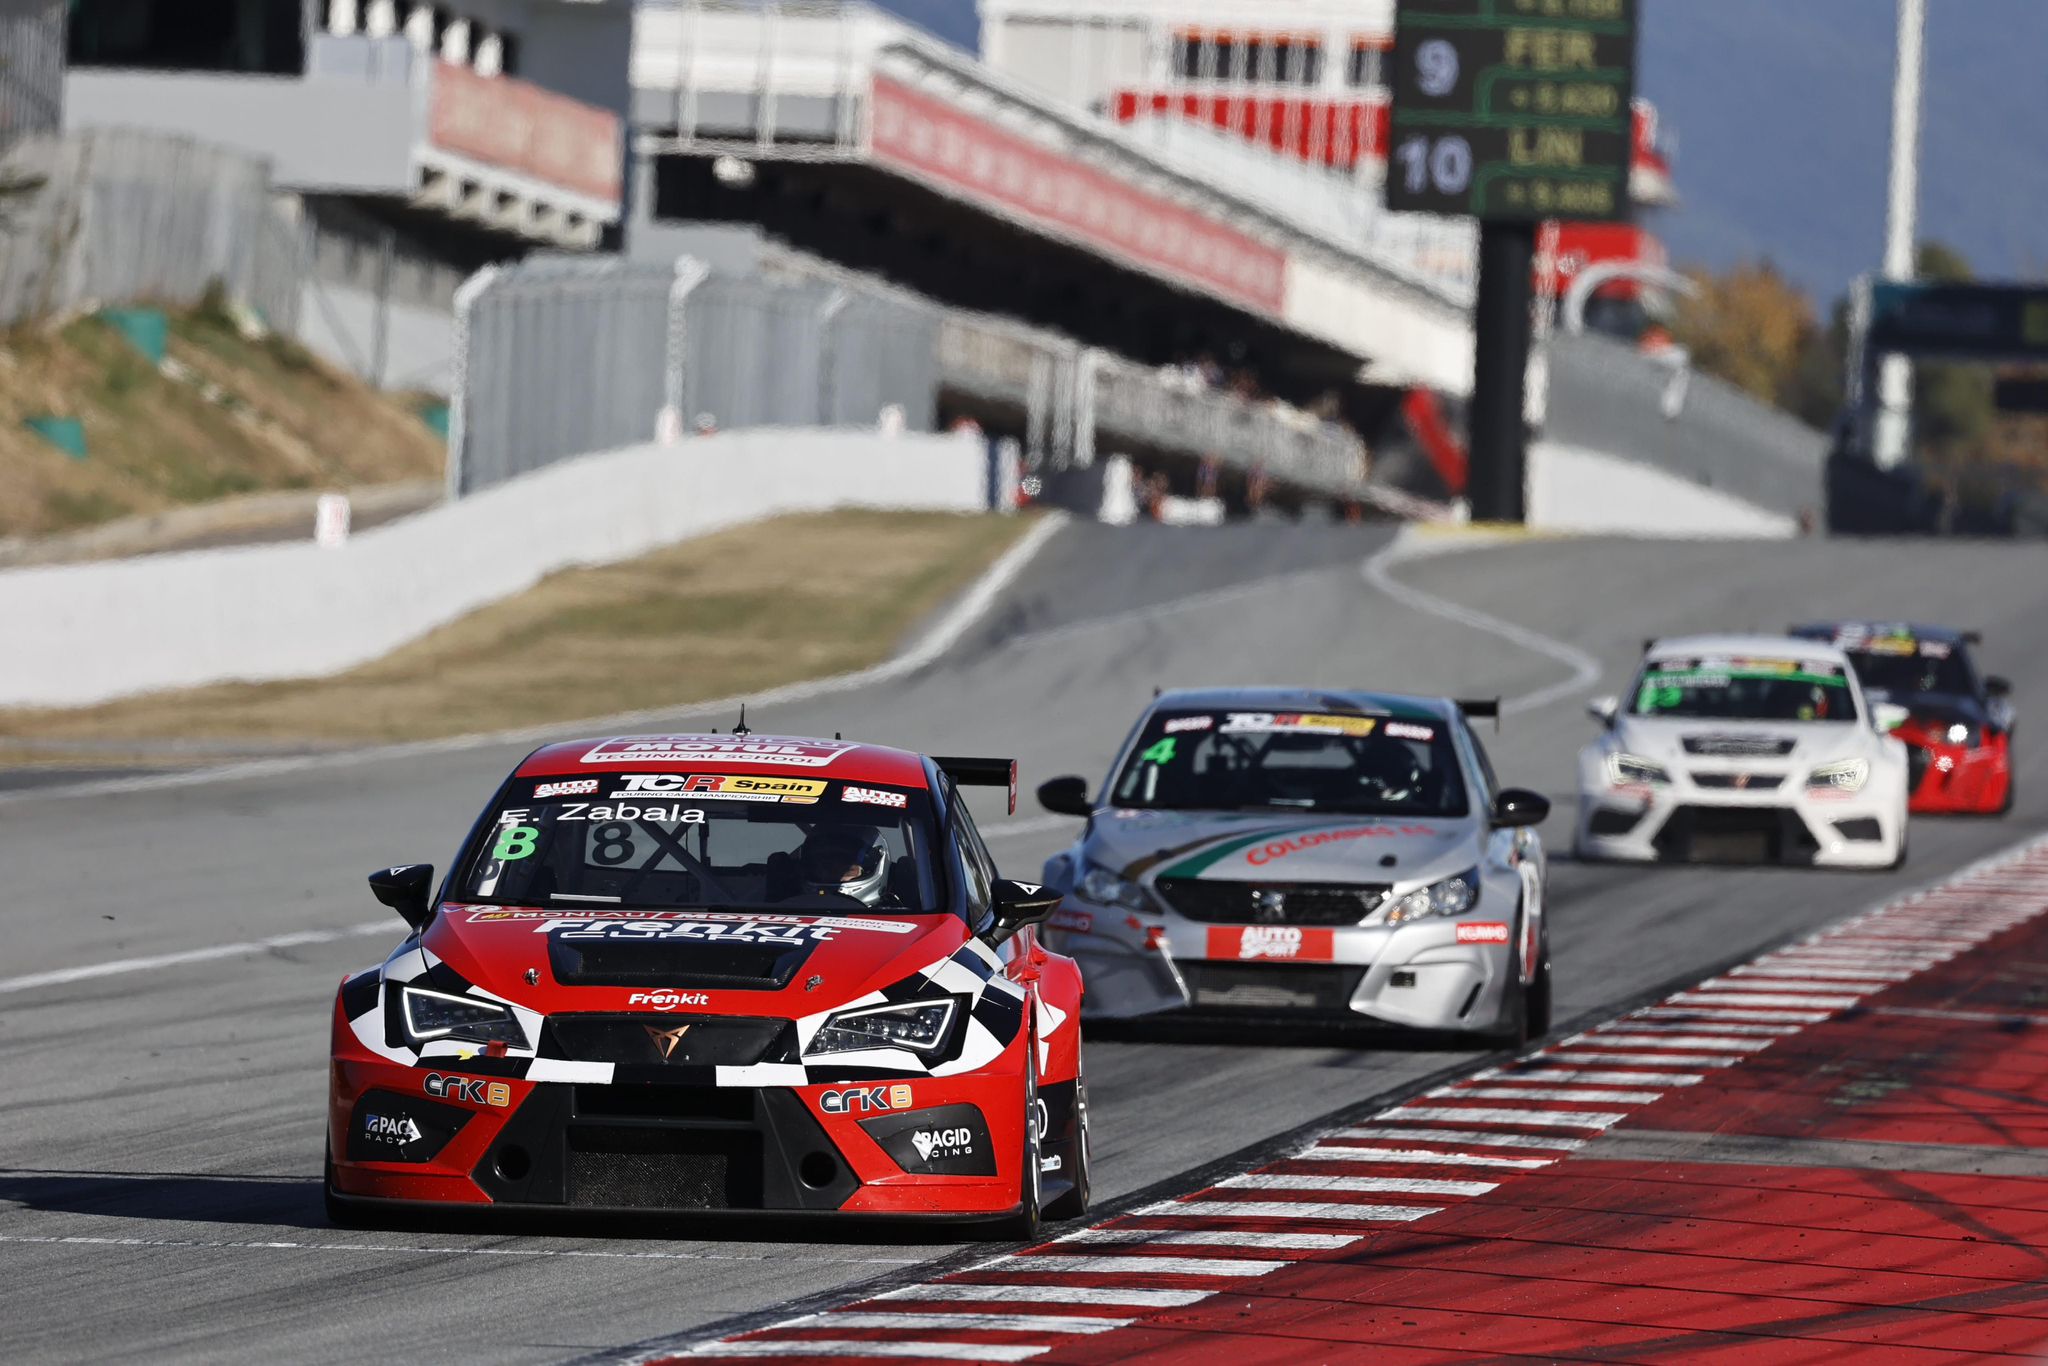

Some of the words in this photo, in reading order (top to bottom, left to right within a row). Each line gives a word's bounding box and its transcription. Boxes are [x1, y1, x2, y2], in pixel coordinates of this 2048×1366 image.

[1414, 38, 1459, 97] 9
[1396, 134, 1472, 195] 10
[595, 752, 718, 760] TECHNICAL
[725, 754, 816, 764] SCHOOL
[623, 743, 806, 755] MOTUL
[1142, 736, 1177, 765] 4
[535, 779, 599, 792] AUTO
[620, 774, 727, 792] TCR
[734, 779, 813, 792] Spain
[843, 786, 906, 801] AUTO
[501, 808, 540, 823] E.
[556, 802, 706, 824] Zabala
[493, 826, 539, 861] 8
[592, 821, 635, 866] 8
[513, 911, 646, 919] MONLAU
[675, 912, 802, 923] MOTUL
[532, 919, 841, 941] Frenkit
[560, 931, 803, 946] CUPRA
[1241, 926, 1303, 943] AUTO
[628, 992, 710, 1006] Frenkit
[920, 1128, 972, 1148] PAGID
